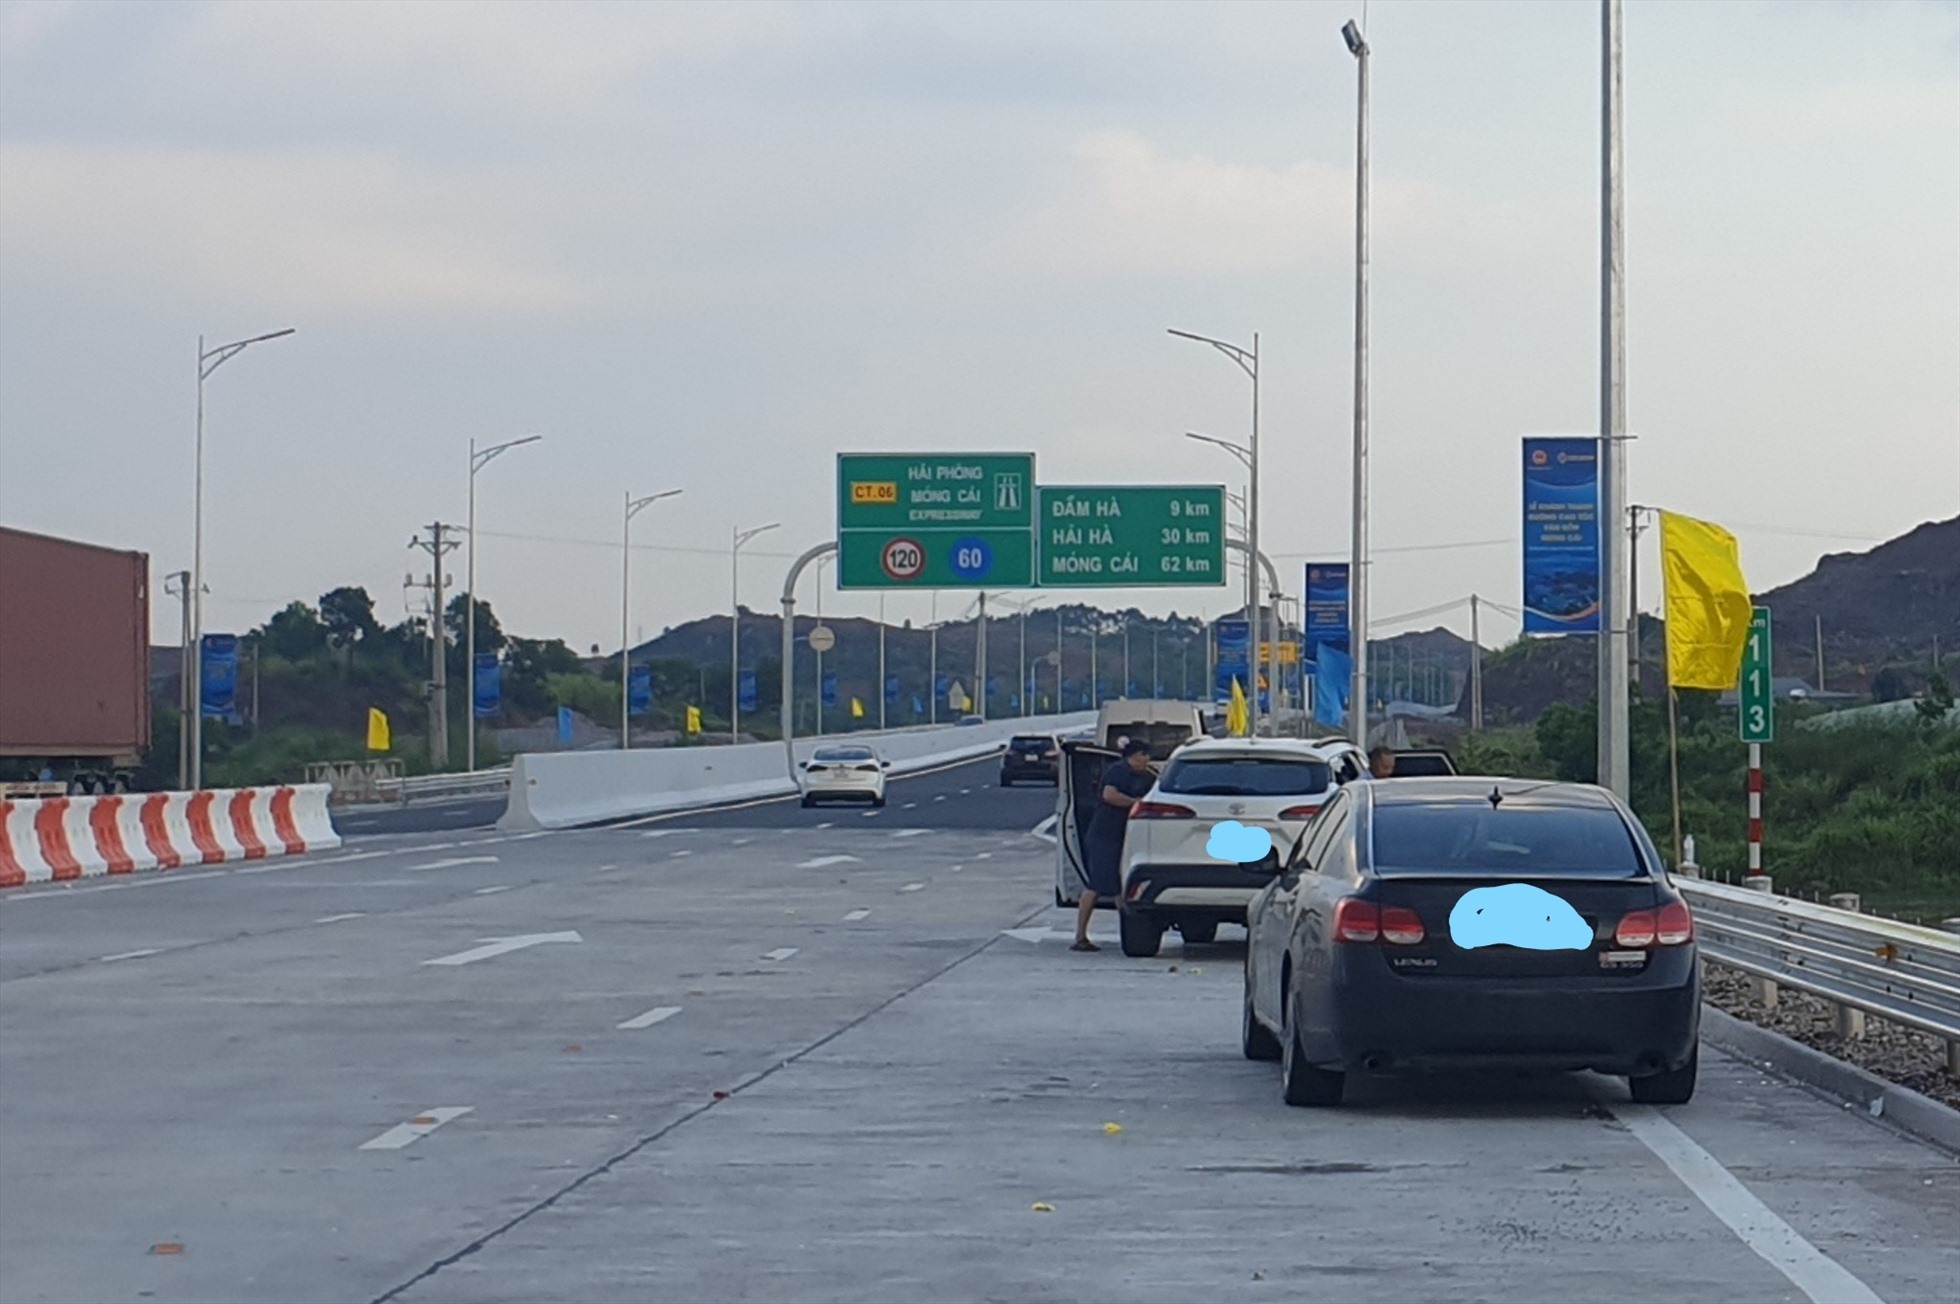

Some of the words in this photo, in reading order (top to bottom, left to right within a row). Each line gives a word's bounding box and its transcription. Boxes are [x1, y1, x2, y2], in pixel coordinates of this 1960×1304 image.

[854, 485, 893, 498] CT.06
[911, 488, 951, 503] MÓNG
[958, 487, 981, 503] CÁI
[1096, 496, 1121, 517] HÀ
[1170, 500, 1180, 517] 9
[1185, 500, 1210, 517] km
[1052, 524, 1082, 544] HẢI
[1089, 524, 1113, 544] HÀ
[1161, 528, 1180, 544] 30
[1185, 528, 1210, 544] km
[889, 549, 918, 568] 120
[958, 548, 982, 568] 60
[1052, 551, 1102, 573] MÓNG
[1110, 552, 1138, 573] CÁI
[1161, 556, 1180, 573] 62
[1185, 556, 1210, 573] km
